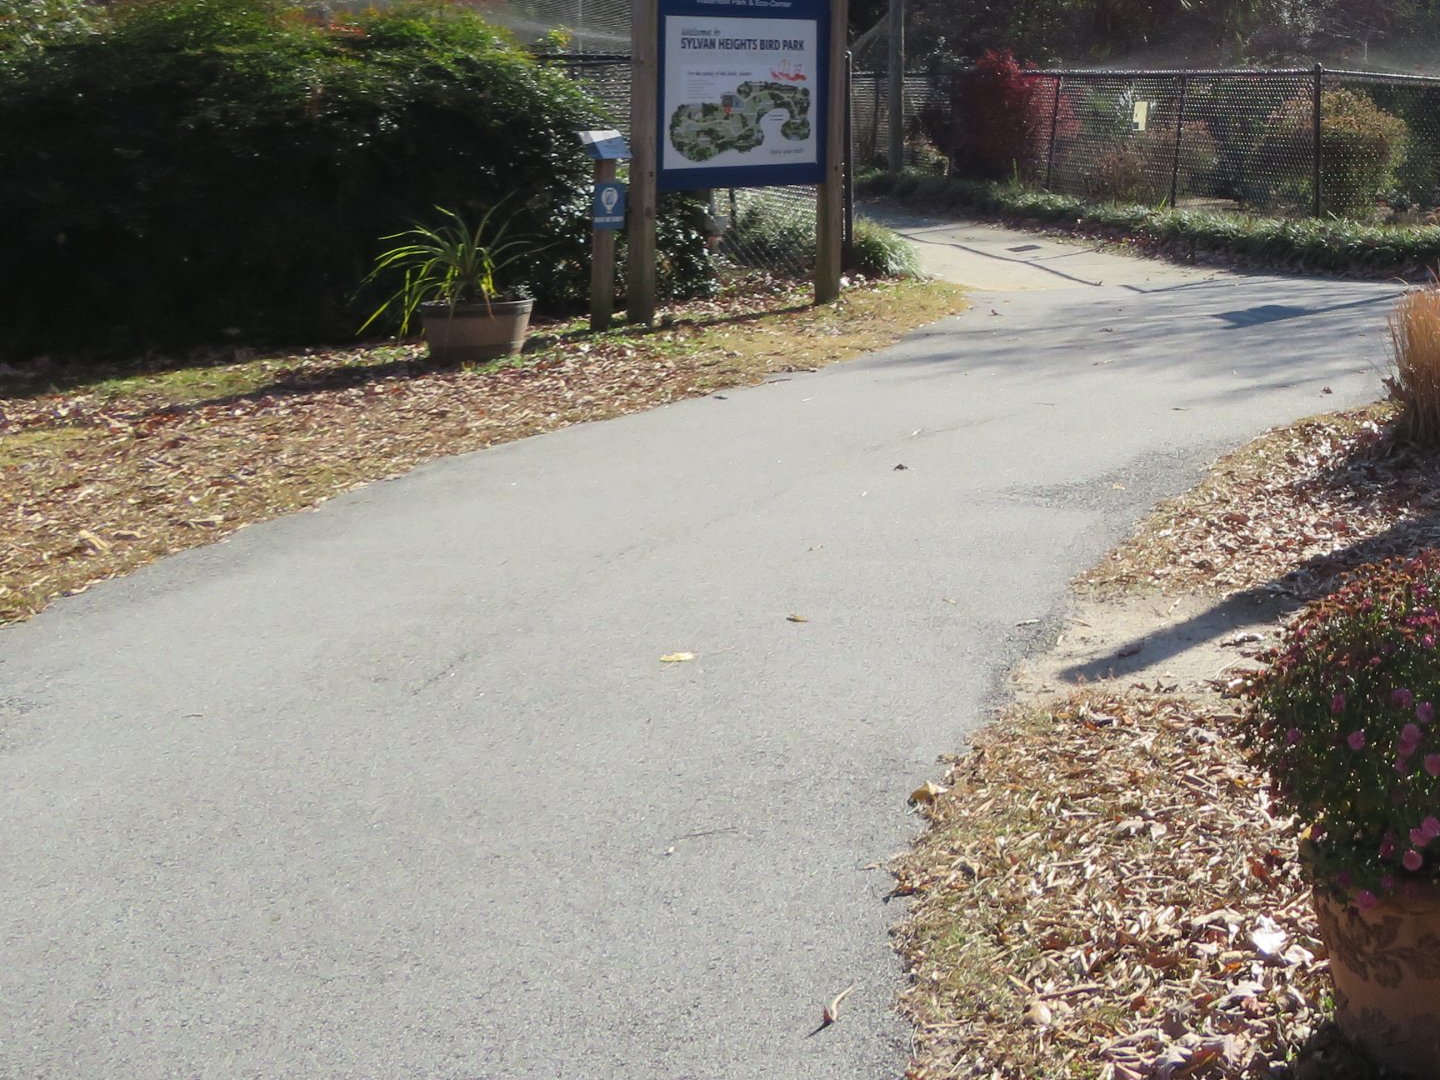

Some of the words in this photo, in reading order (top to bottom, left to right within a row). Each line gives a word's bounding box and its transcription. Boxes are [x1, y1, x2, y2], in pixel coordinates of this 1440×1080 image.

[755, 0, 793, 8] Eco-Center
[681, 38, 716, 50] SYLVAN
[718, 39, 758, 51] HEIGHTS
[760, 40, 781, 51] BIRD
[782, 40, 805, 51] PARK
